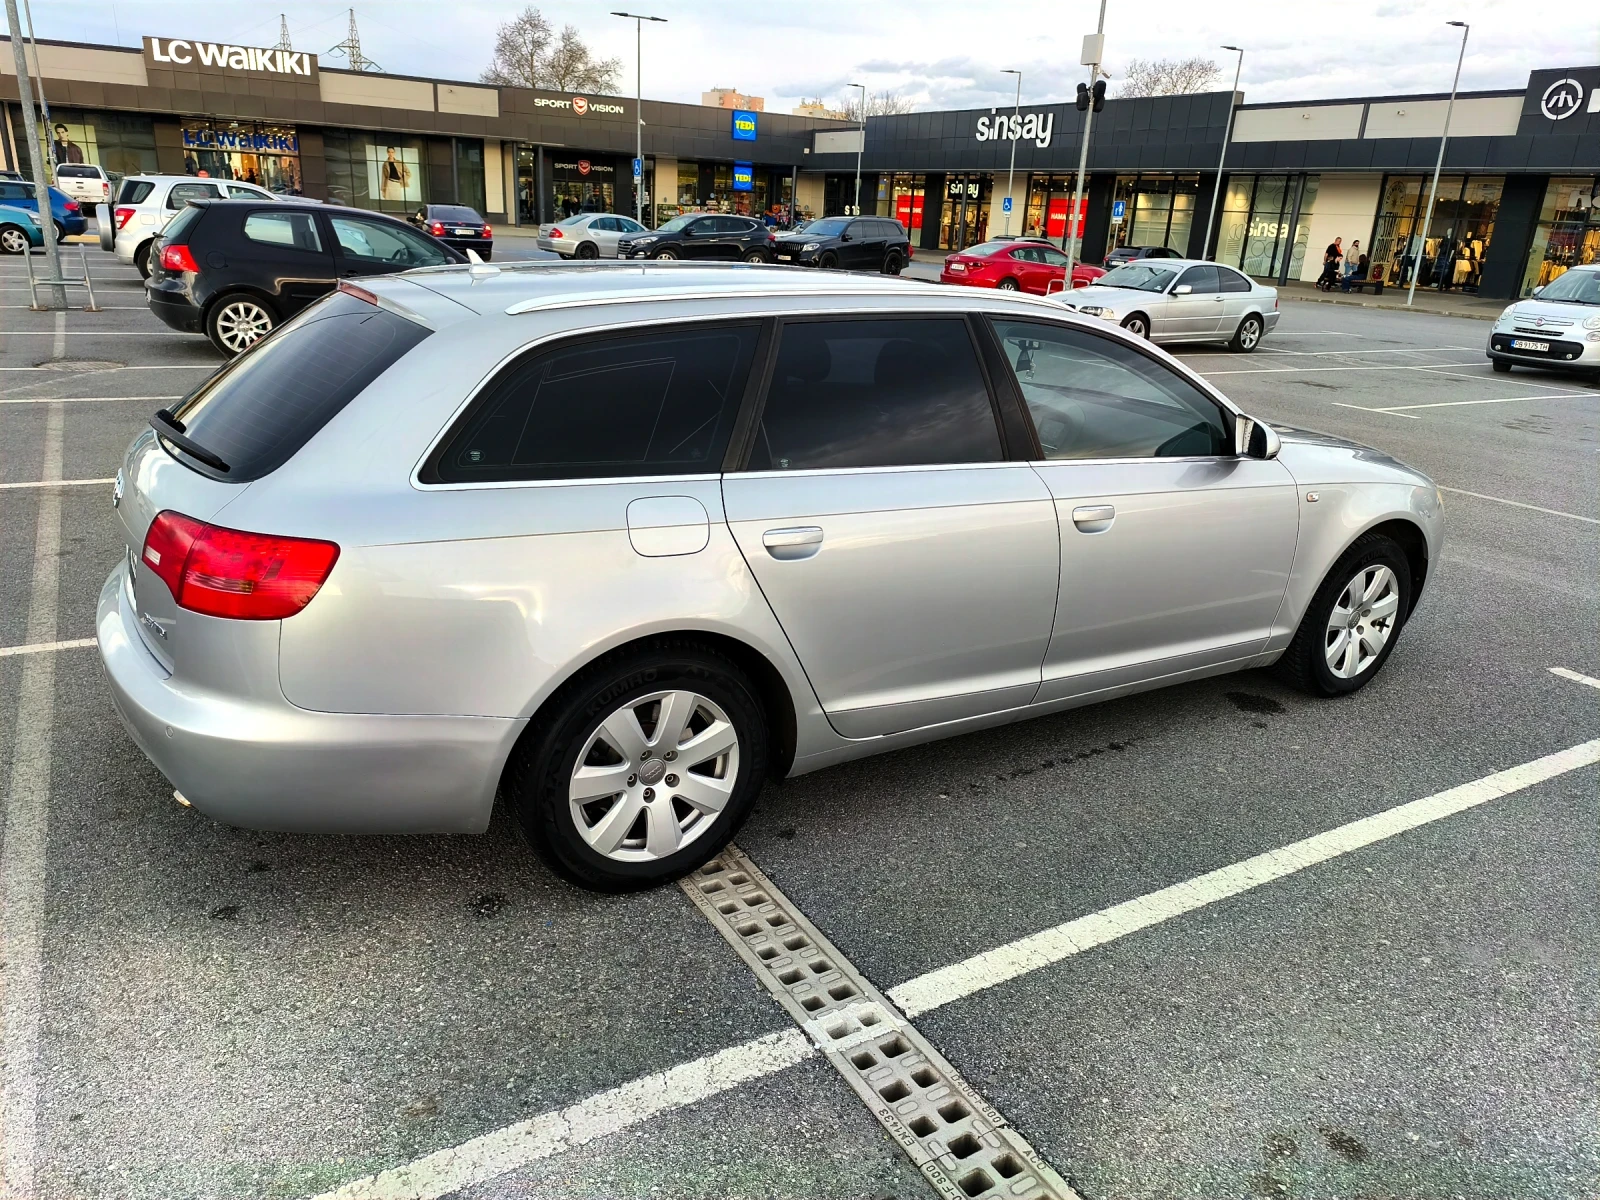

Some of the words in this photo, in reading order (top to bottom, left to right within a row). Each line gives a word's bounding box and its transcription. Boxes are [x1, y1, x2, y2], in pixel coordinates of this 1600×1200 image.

[151, 37, 193, 64] LC
[533, 98, 571, 109] SPORT
[589, 103, 624, 114] VISION
[183, 128, 211, 146] LC
[975, 107, 1054, 148] sinsay
[949, 181, 980, 198] sinay
[586, 668, 659, 717] KUMHO
